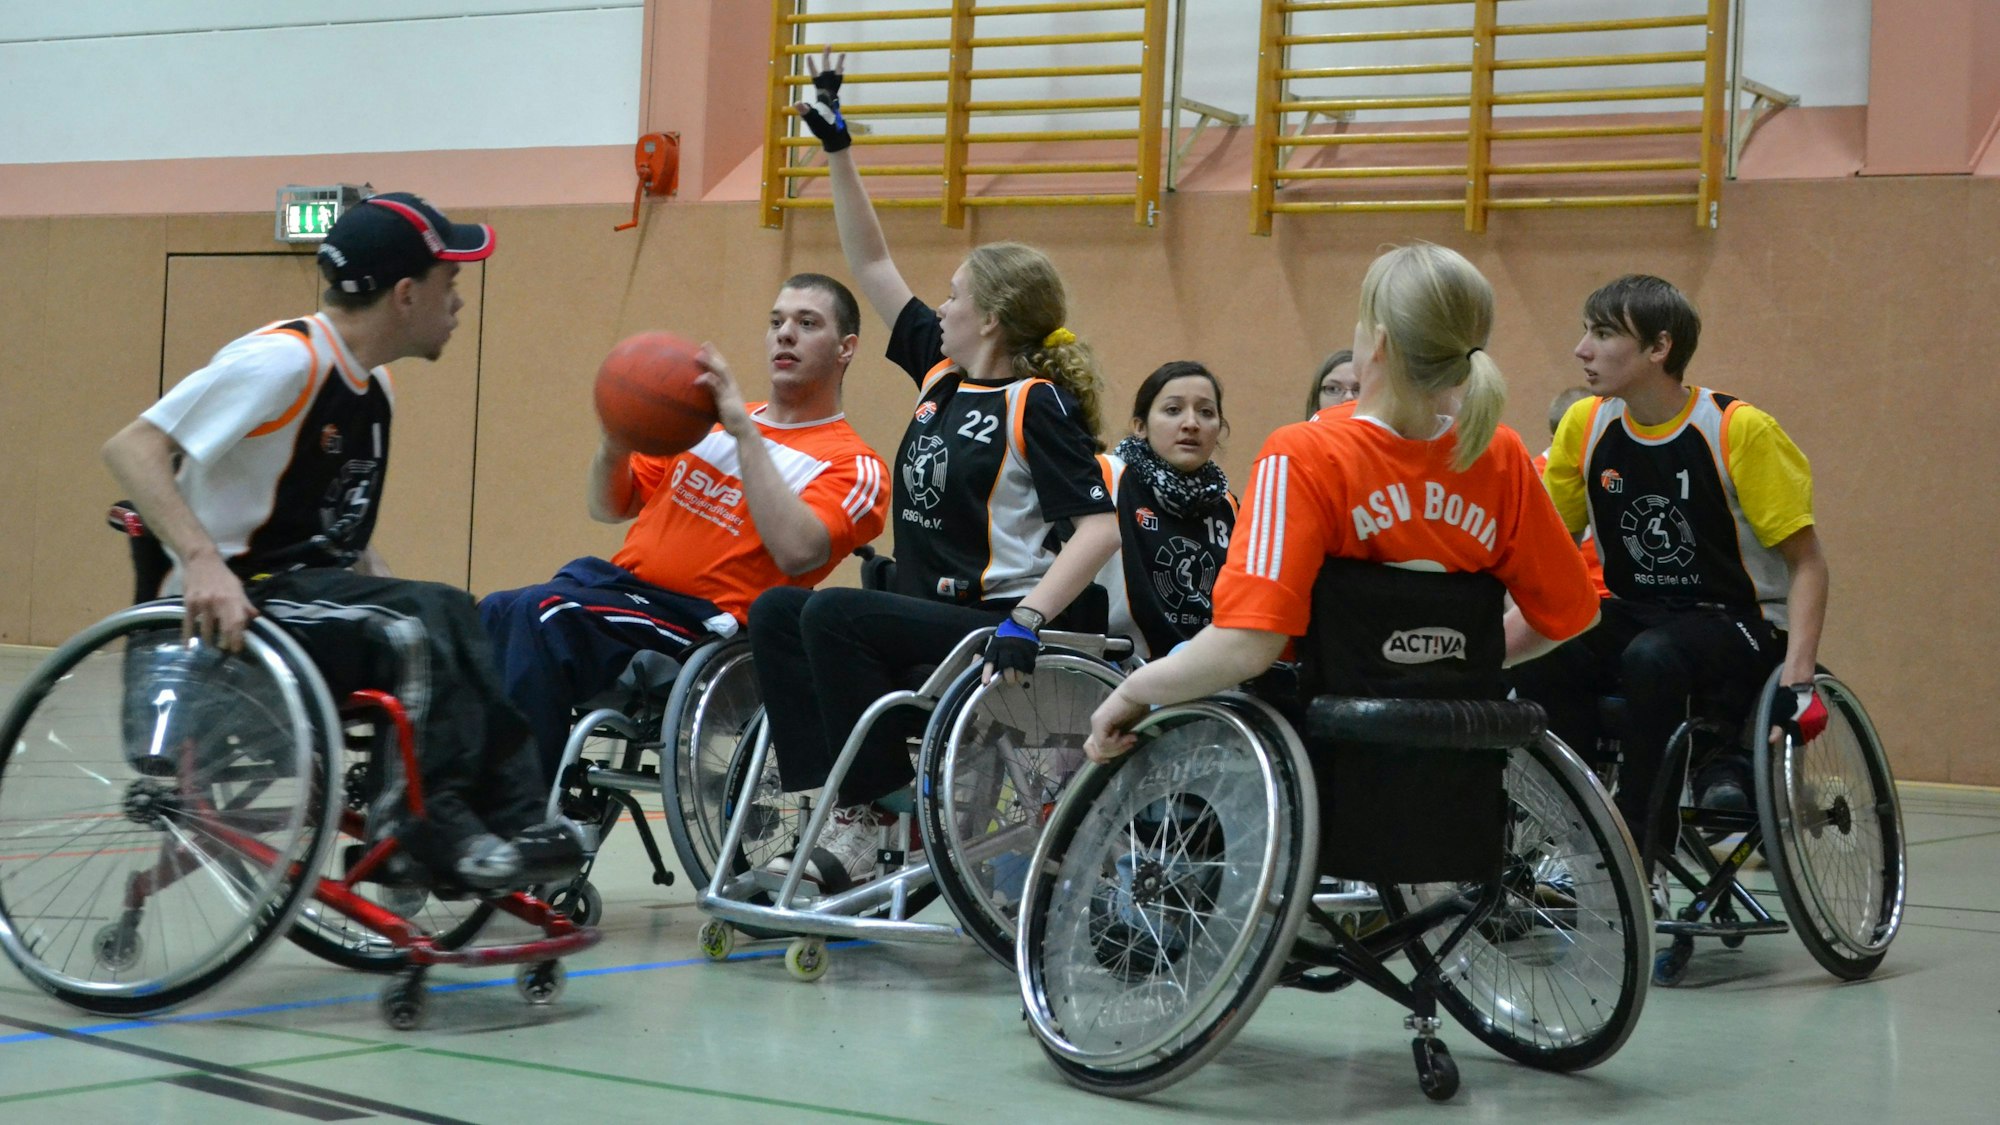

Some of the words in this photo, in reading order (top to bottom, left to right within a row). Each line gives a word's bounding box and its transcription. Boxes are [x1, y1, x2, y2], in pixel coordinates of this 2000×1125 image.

[957, 410, 999, 444] 22
[684, 469, 743, 507] SWB
[1676, 469, 1690, 500] 1
[902, 508, 919, 522] RSG
[924, 518, 942, 530] e.V.
[1351, 482, 1412, 541] ASV
[1203, 516, 1229, 549] 13
[1634, 573, 1655, 584] RSG
[1681, 574, 1702, 585] e.V.
